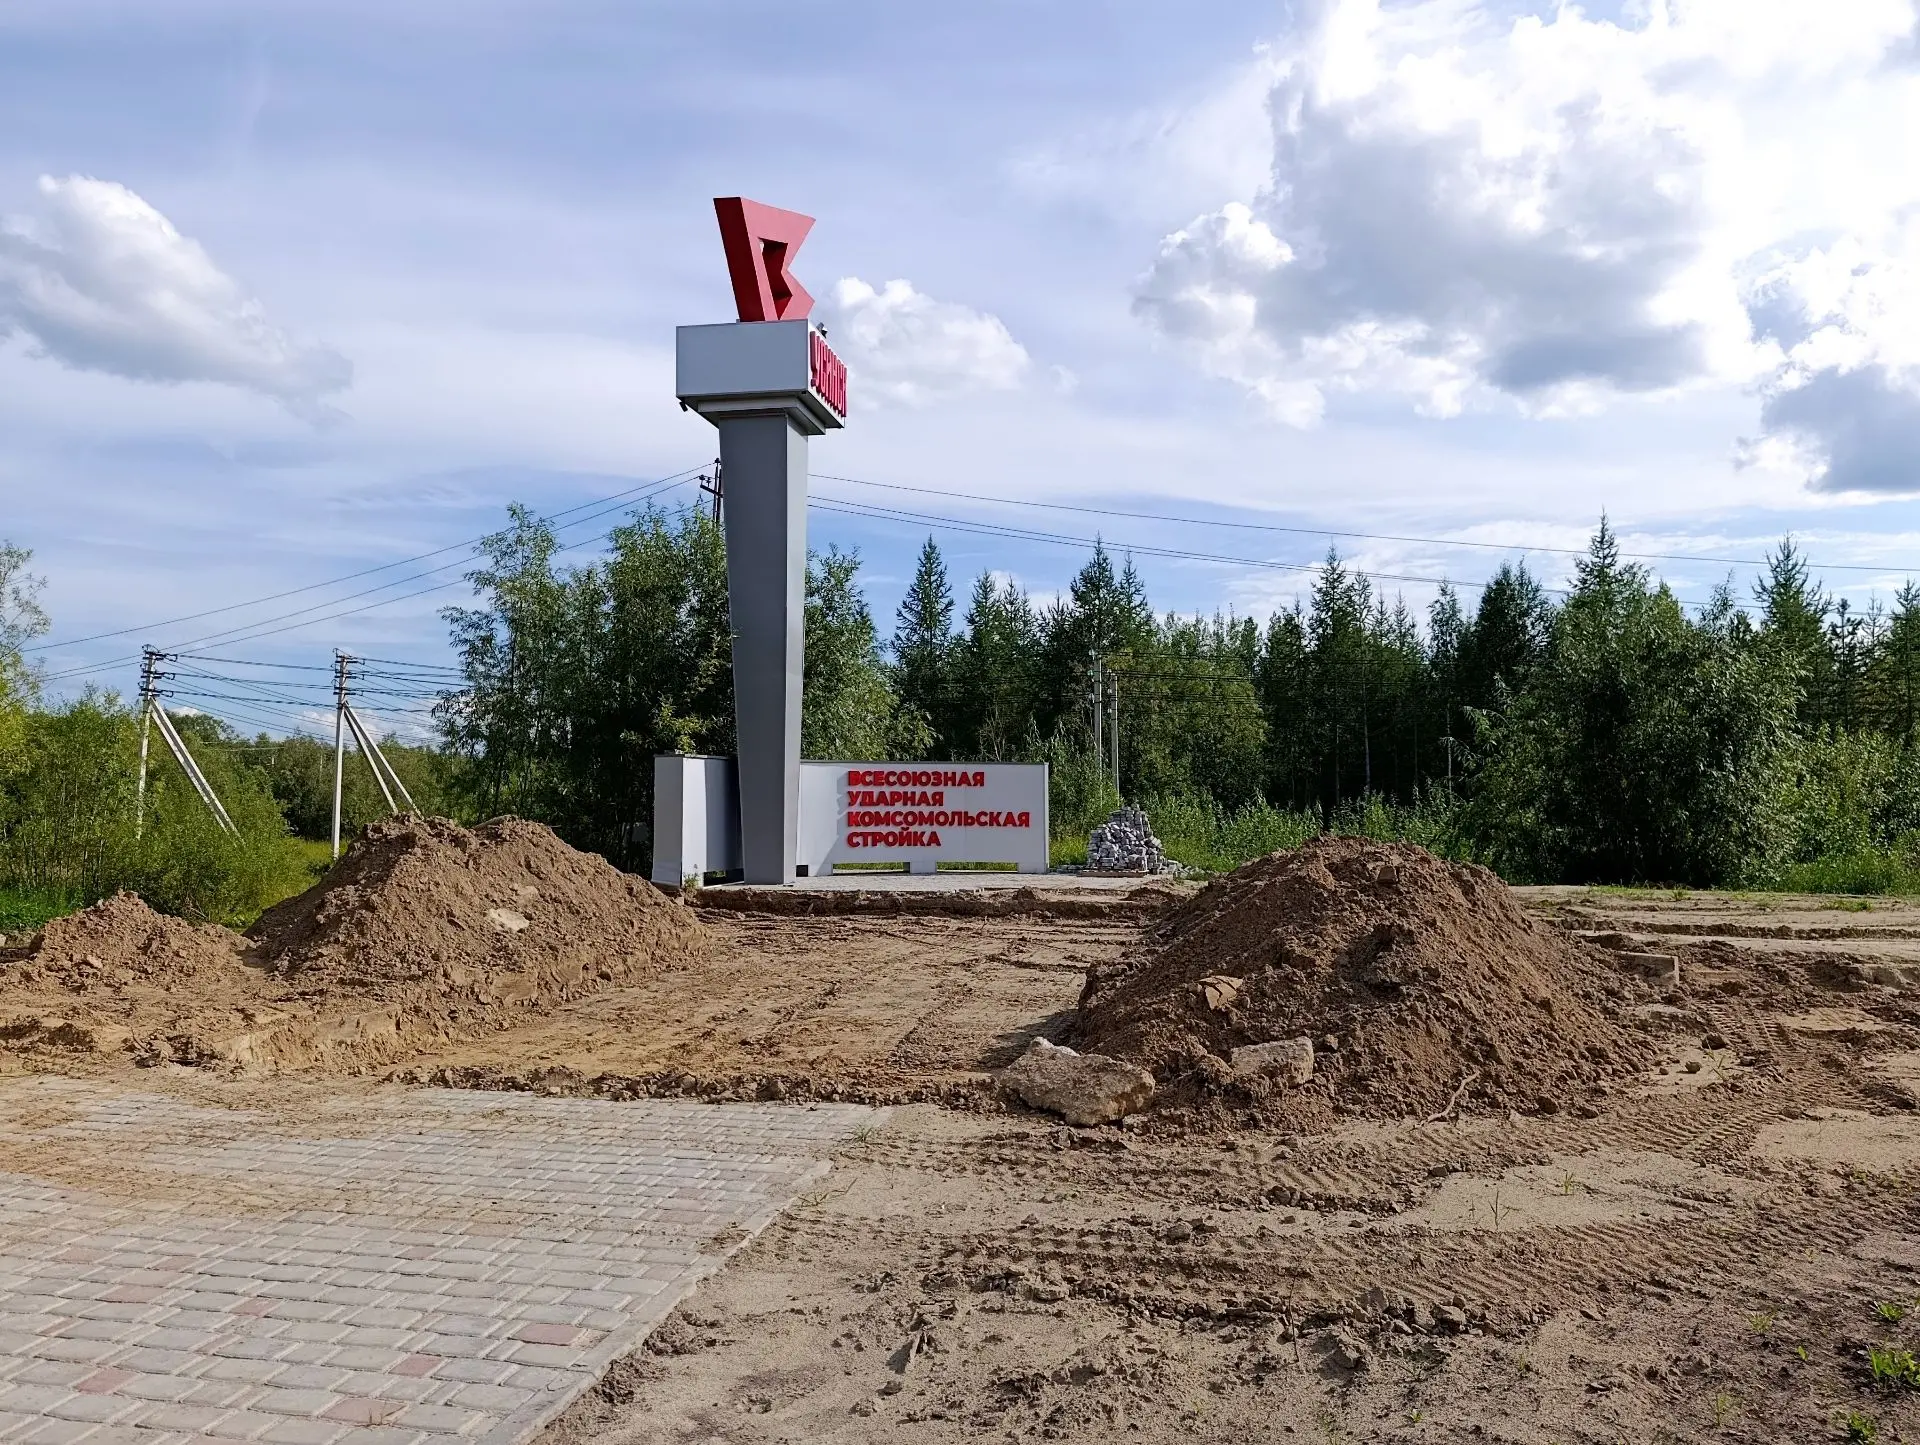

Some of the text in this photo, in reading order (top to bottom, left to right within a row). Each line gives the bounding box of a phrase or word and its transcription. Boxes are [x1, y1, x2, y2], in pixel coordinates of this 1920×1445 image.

[847, 770, 985, 787] ВСЕСОЮЗНАЯ
[847, 790, 944, 807] УДАРНАЯ
[847, 810, 1030, 828] КОМСОМОЛЬСКАЯ
[847, 827, 942, 848] СТРОЙКА
